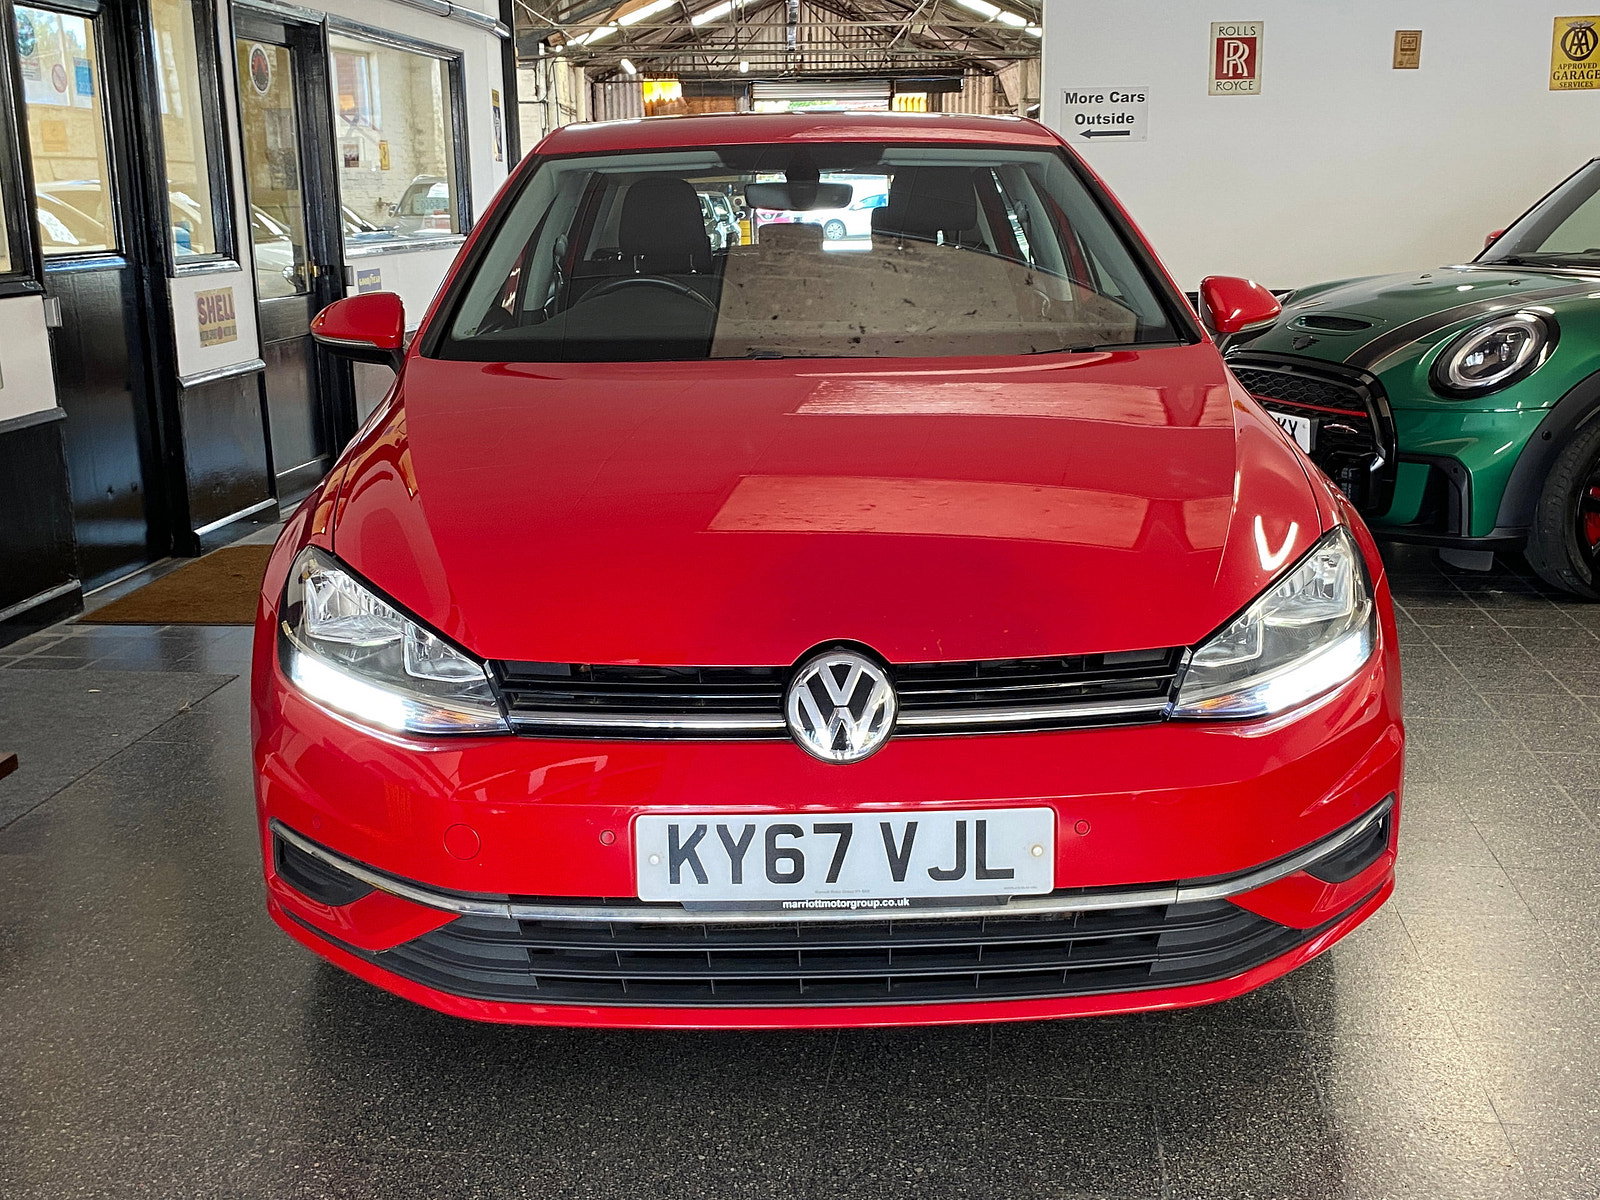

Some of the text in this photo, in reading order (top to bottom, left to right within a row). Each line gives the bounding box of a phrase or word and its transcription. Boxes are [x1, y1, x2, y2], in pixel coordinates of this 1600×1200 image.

[1218, 26, 1256, 36] ROLLS
[1557, 62, 1598, 70] APPROVED
[1552, 70, 1600, 81] GARAGE
[1215, 81, 1254, 91] ROYCE
[1065, 91, 1145, 104] More Cars
[1074, 112, 1135, 125] Outside
[197, 293, 236, 326] SHELL
[667, 819, 1015, 886] KY67 VJL
[782, 898, 910, 910] marriottmotorgroup.co.uk
